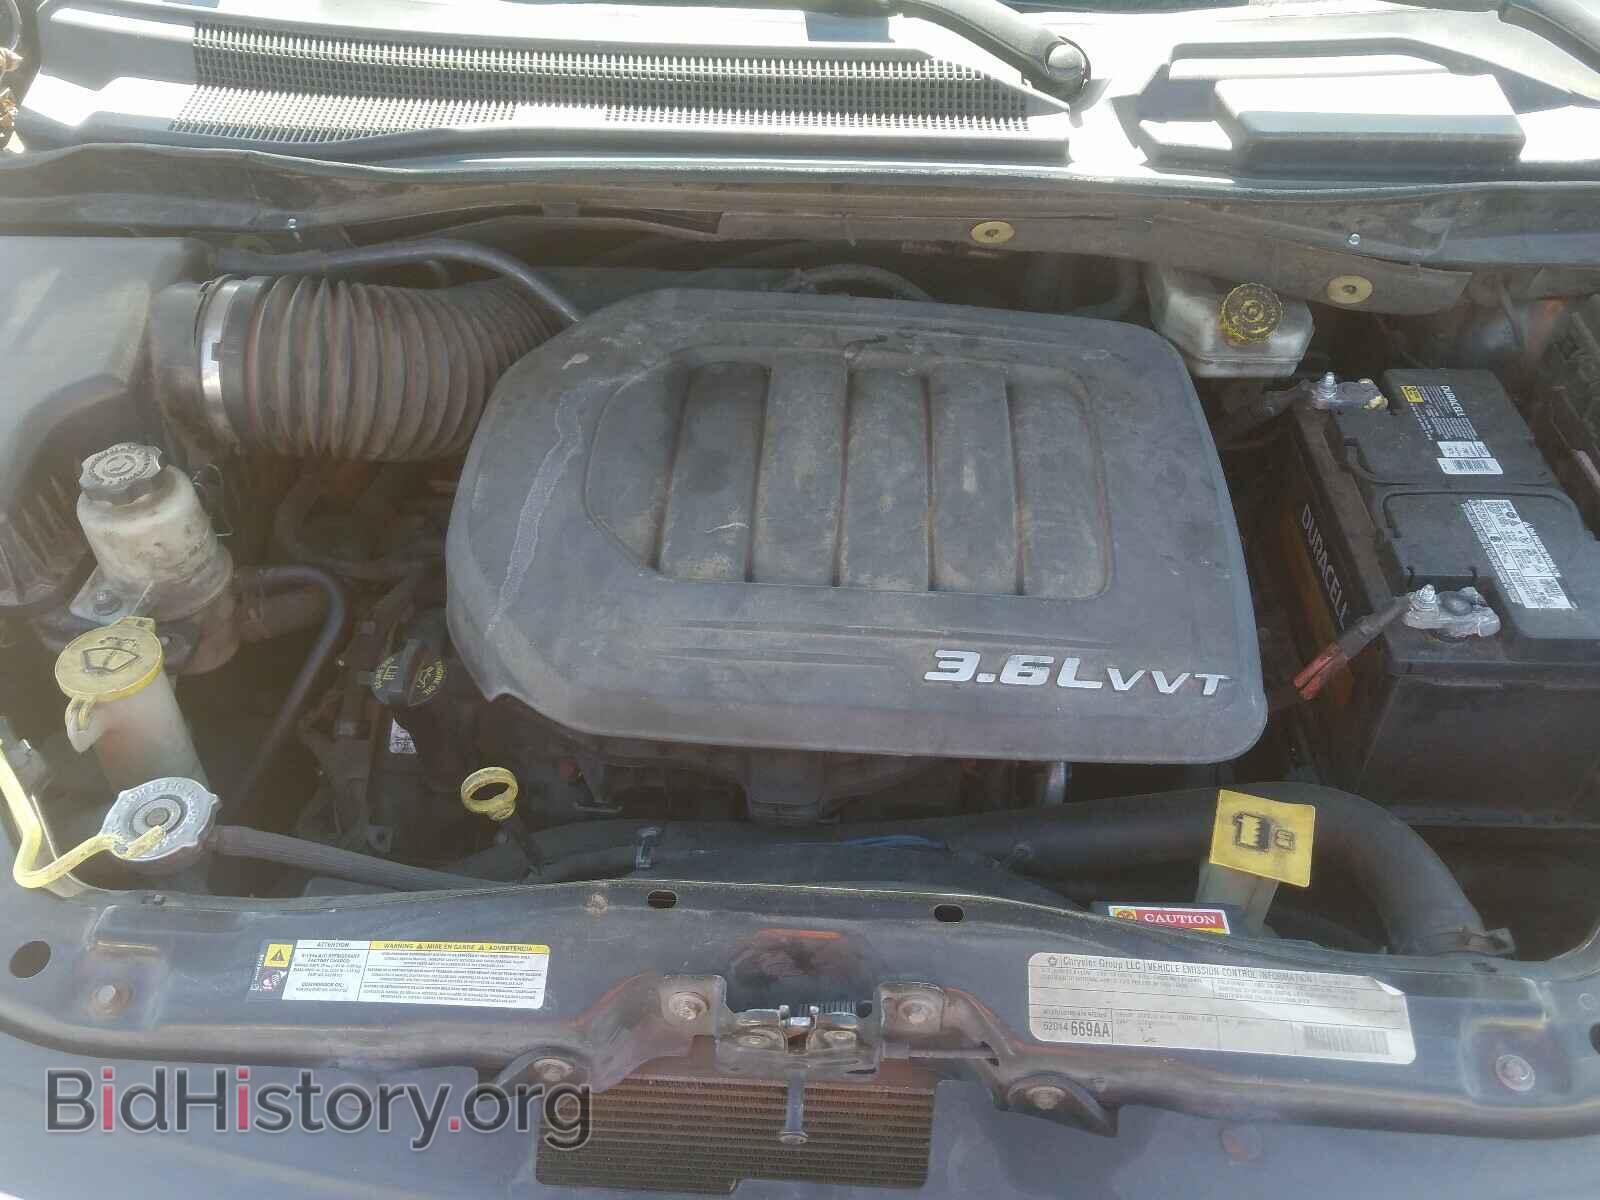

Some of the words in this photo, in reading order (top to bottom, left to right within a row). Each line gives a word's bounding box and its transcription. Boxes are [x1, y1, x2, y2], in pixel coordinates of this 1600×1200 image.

[1440, 385, 1466, 417] DURACELL
[1302, 503, 1347, 631] DURACELL
[924, 649, 1103, 689] 3.6L
[1106, 666, 1233, 696] VVT
[1144, 912, 1216, 925] CAUTION
[1101, 958, 1123, 970] Group
[1125, 960, 1141, 970] LLC
[1148, 962, 1180, 973] VEHICLE
[1221, 967, 1256, 979] CONTROL
[1071, 1020, 1111, 1037] 669AA
